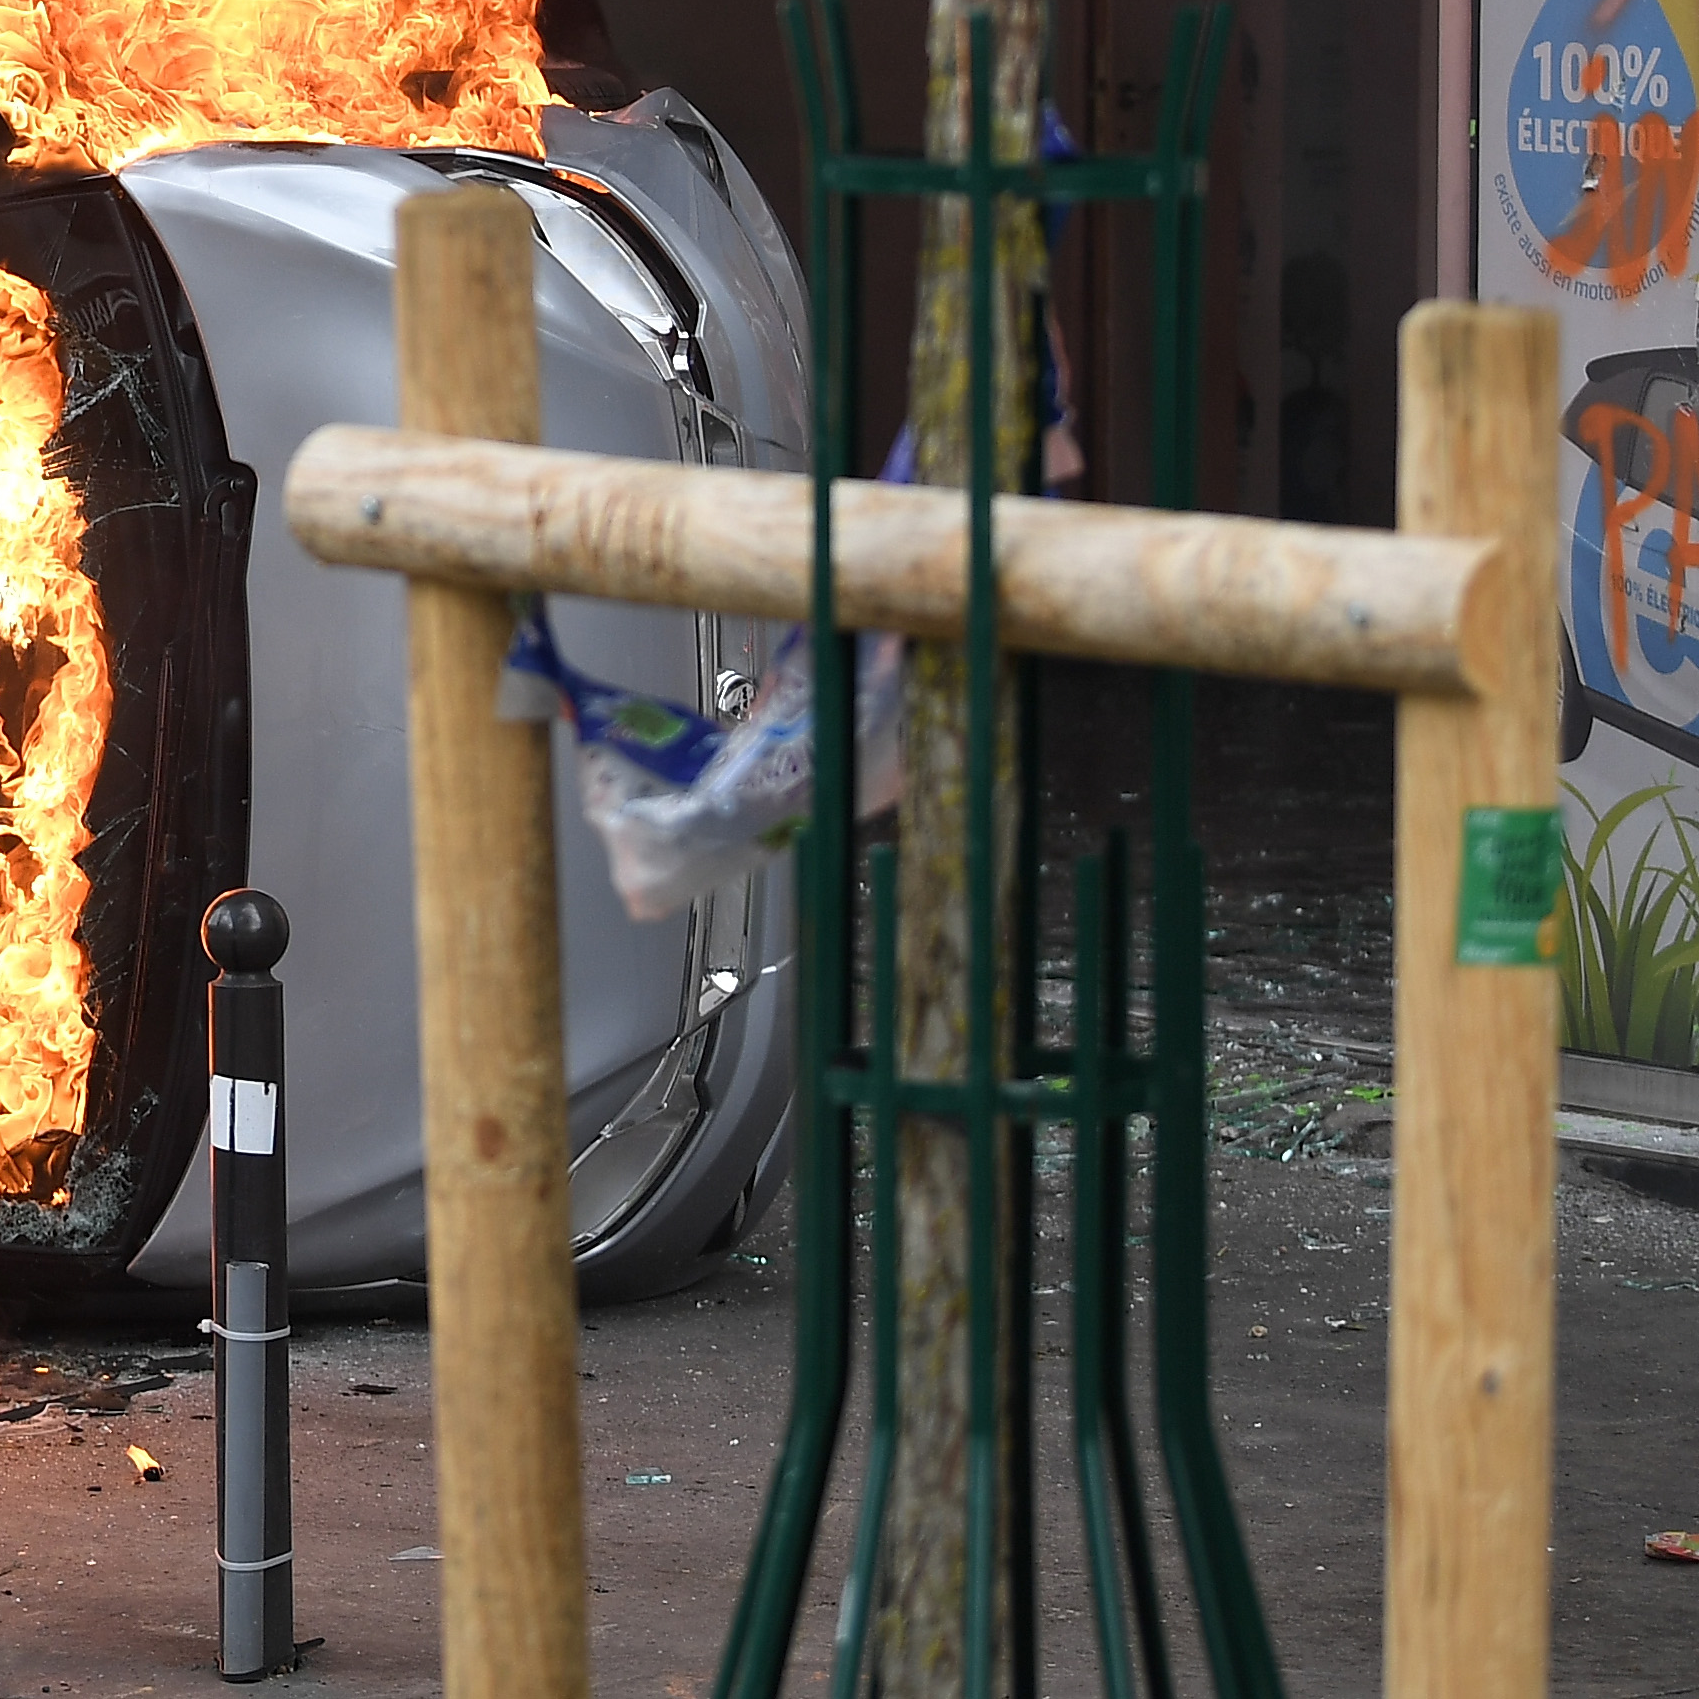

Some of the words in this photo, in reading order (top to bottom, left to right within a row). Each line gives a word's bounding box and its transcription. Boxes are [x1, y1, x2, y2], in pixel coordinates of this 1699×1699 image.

[1533, 41, 1669, 107] 100%
[1494, 173, 1522, 236] existe
[1552, 268, 1572, 292] en
[1575, 259, 1669, 301] motorisation
